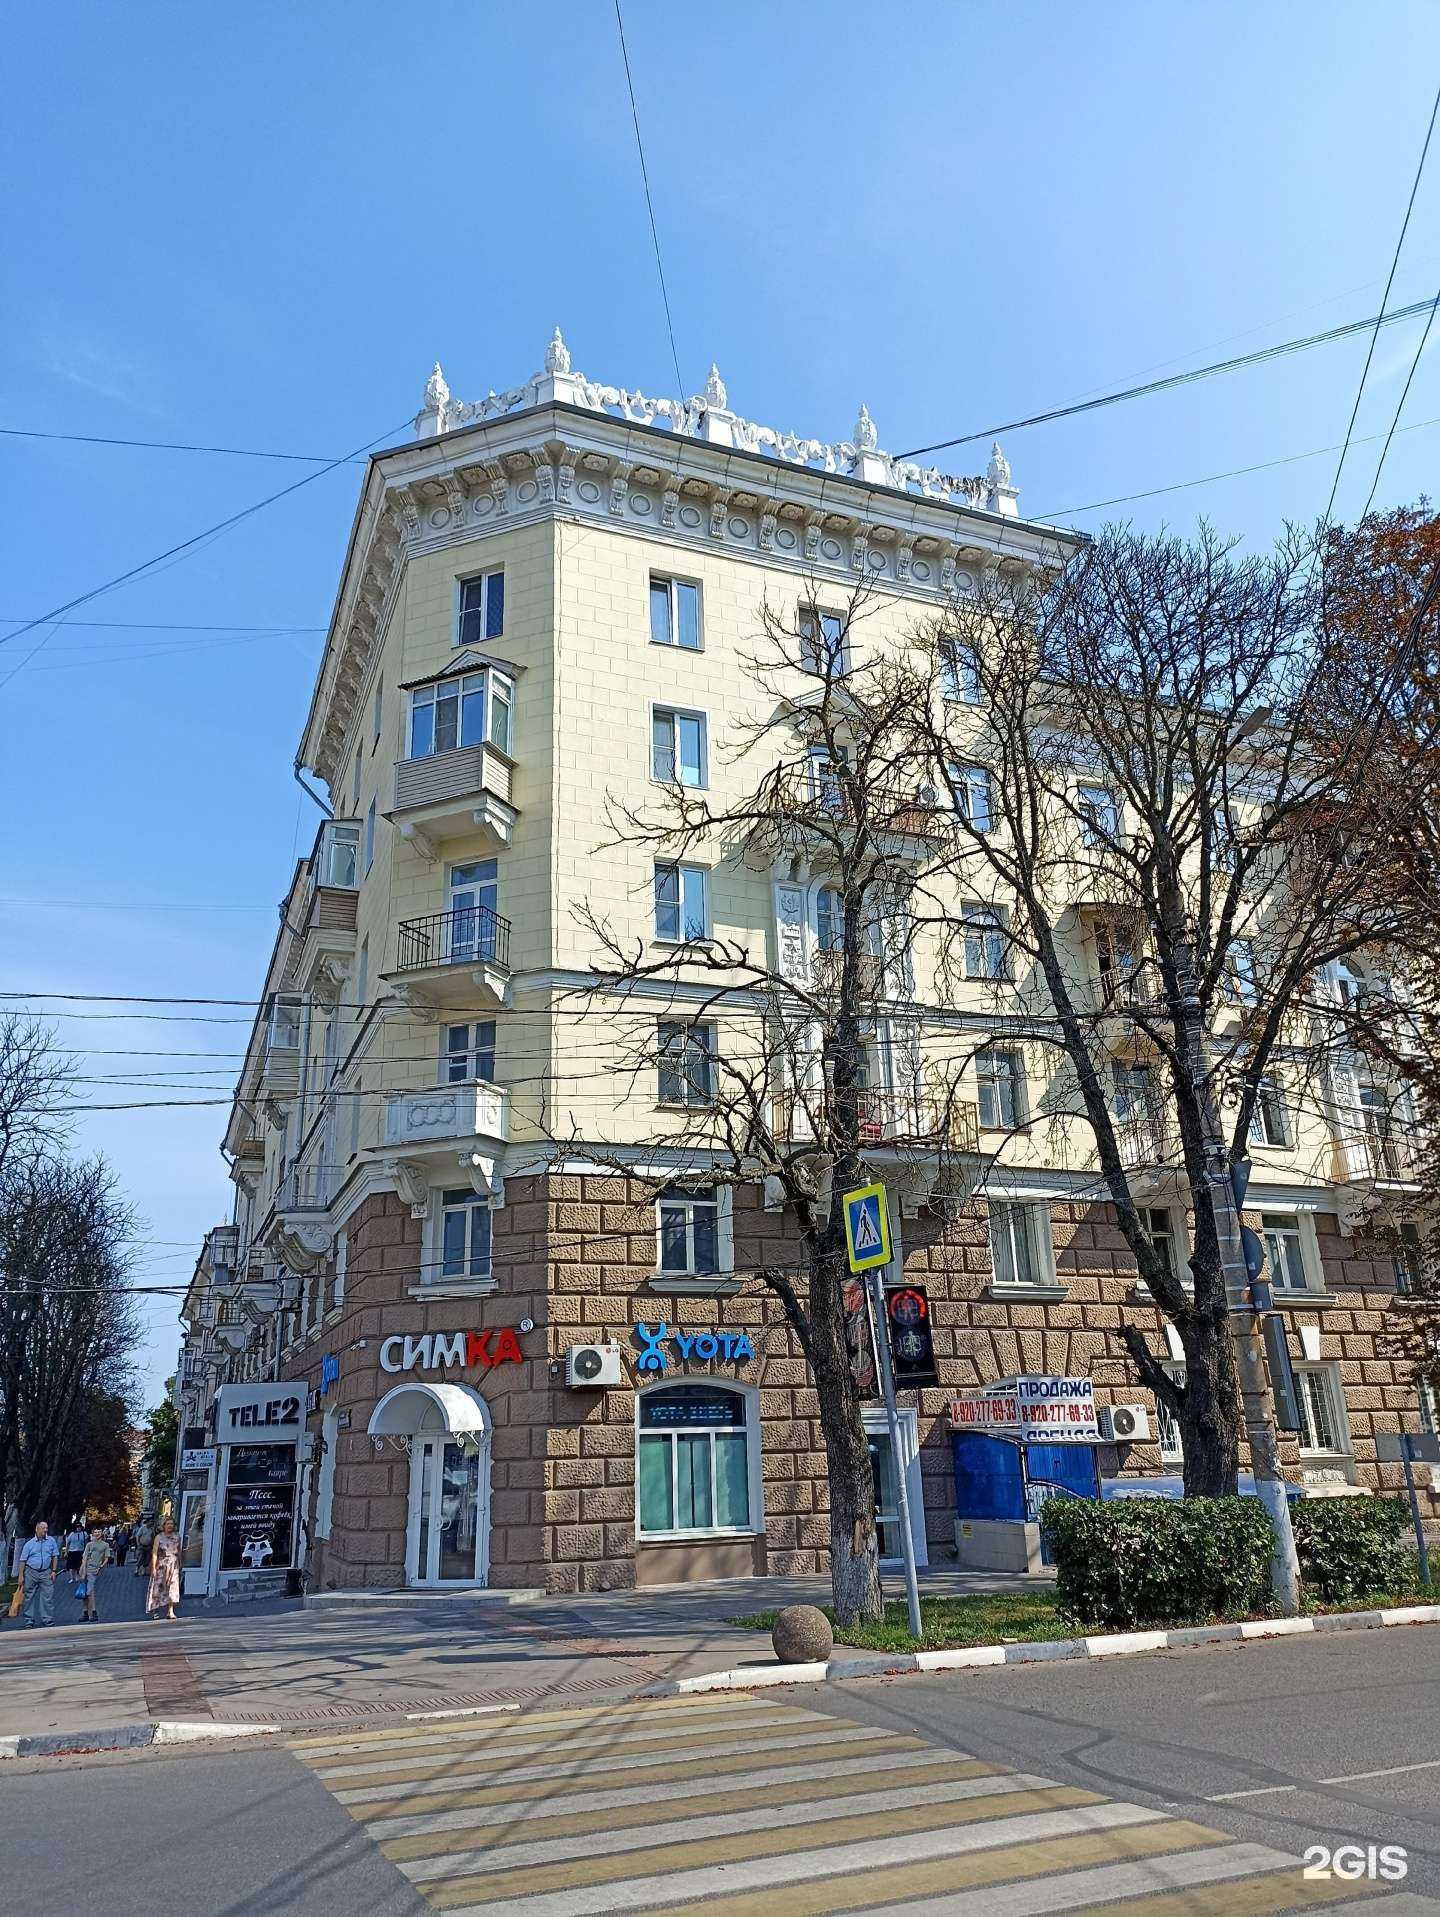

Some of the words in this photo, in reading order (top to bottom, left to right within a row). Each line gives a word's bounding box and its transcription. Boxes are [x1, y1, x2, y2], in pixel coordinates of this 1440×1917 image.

[379, 1328, 523, 1373] СИМКА
[676, 1331, 756, 1361] YOTA
[1018, 1381, 1093, 1398] ПРОДАЖА
[228, 1396, 300, 1427] TELE2
[952, 1399, 1017, 1423] 8-920-277-69-33
[1021, 1403, 1096, 1423] 8-920-277-69-33
